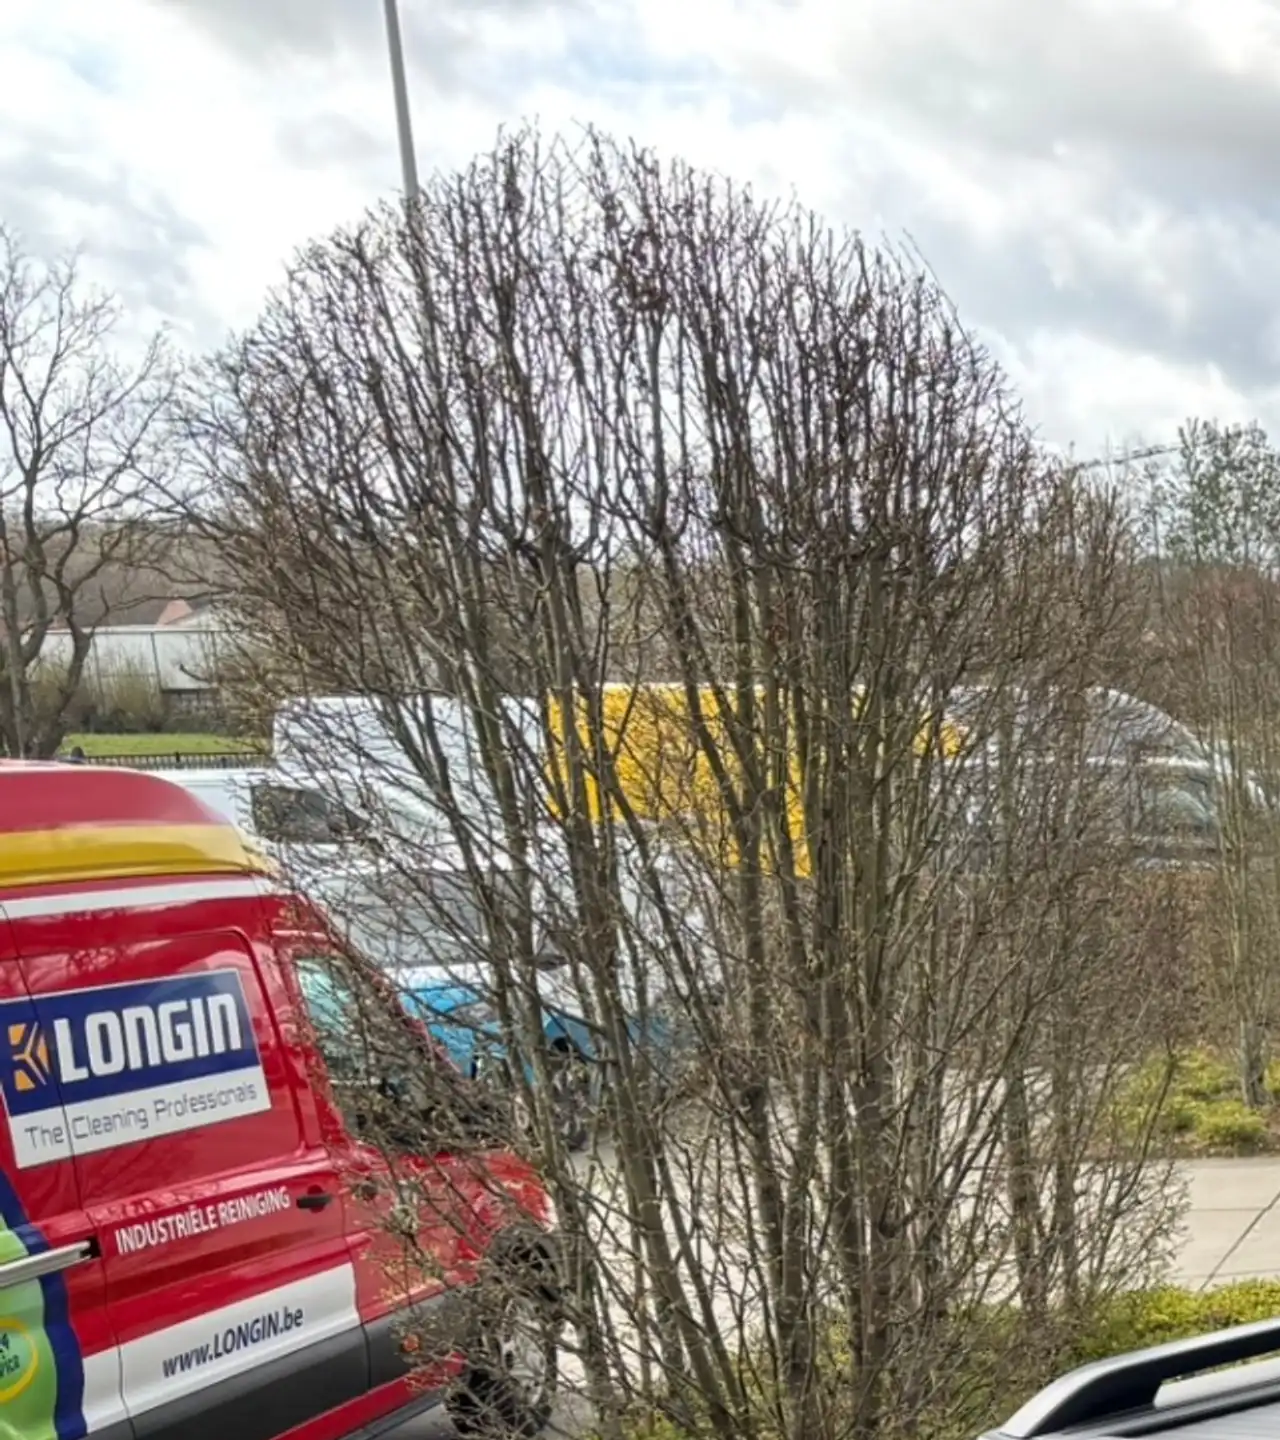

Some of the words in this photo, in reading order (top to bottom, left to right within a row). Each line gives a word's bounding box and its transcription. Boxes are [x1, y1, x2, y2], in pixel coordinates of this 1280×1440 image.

[53, 994, 241, 1083] LONGIN
[25, 1125, 64, 1149] The
[71, 1107, 149, 1140] Cleaning
[153, 1081, 257, 1121] Professionals
[115, 1206, 217, 1255] INDUSTRIËLE
[218, 1186, 291, 1227] REINIGING
[162, 1306, 304, 1378] www.LONGIN.be
